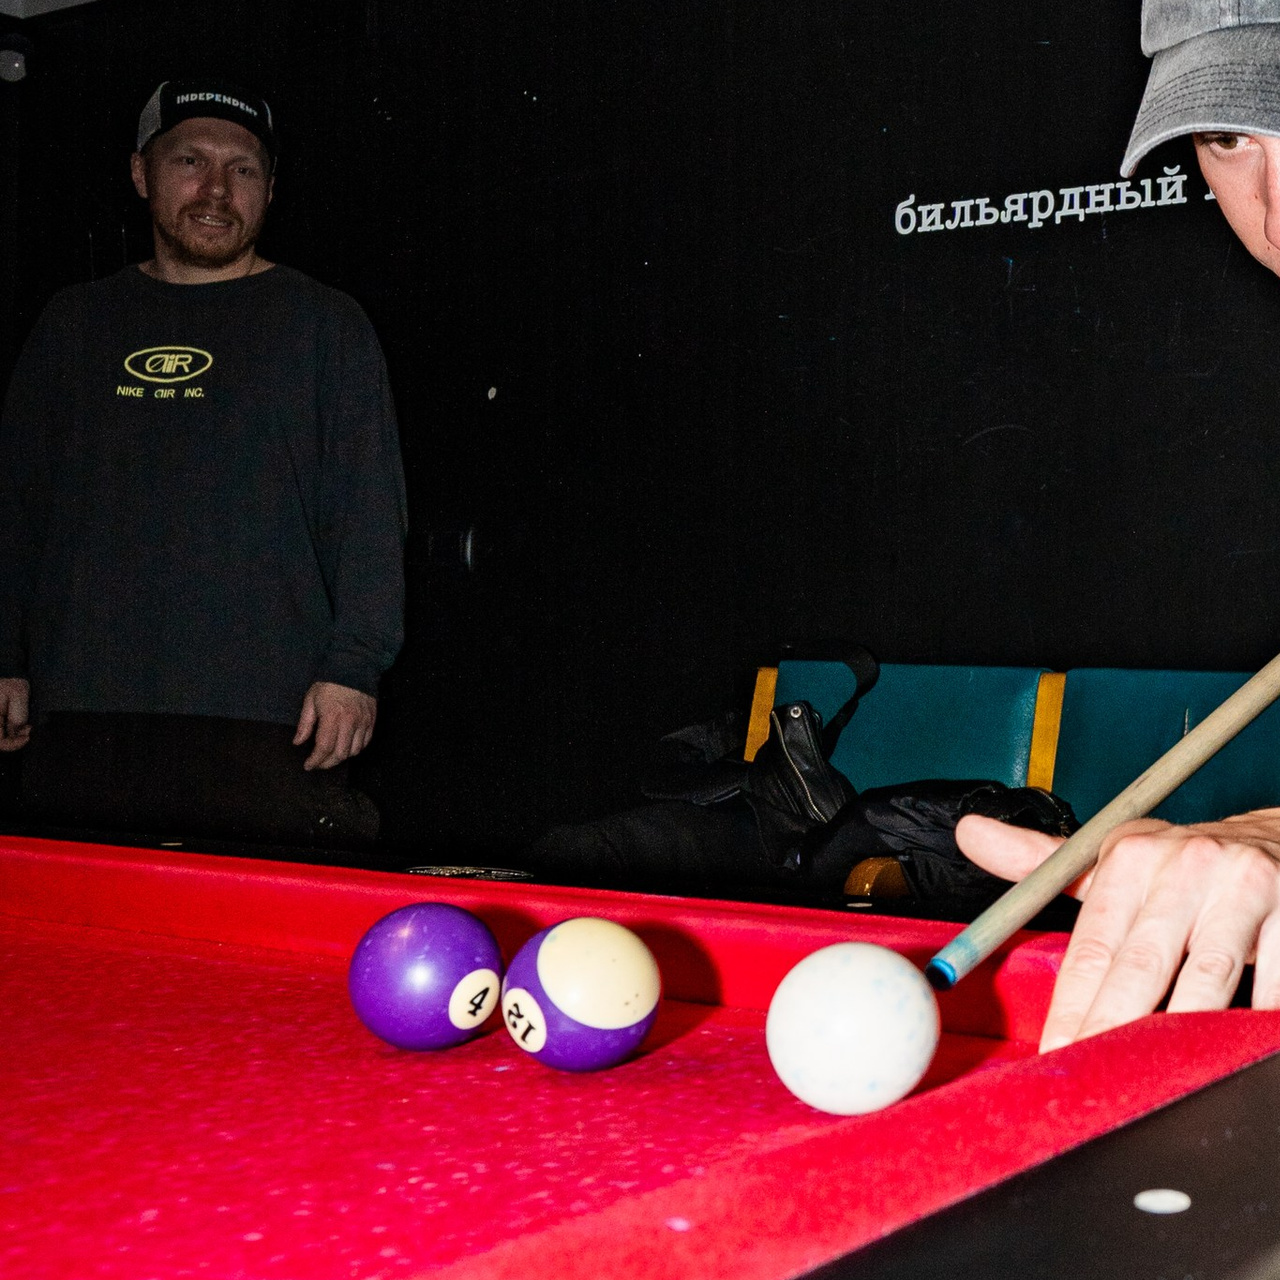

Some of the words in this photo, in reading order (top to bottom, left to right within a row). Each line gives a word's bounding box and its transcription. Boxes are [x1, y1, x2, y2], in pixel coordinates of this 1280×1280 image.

[894, 164, 1188, 235] бильярдный
[116, 385, 145, 398] NIKE
[183, 387, 205, 398] INC.
[467, 986, 490, 1017] 4
[507, 1002, 537, 1045] 12
